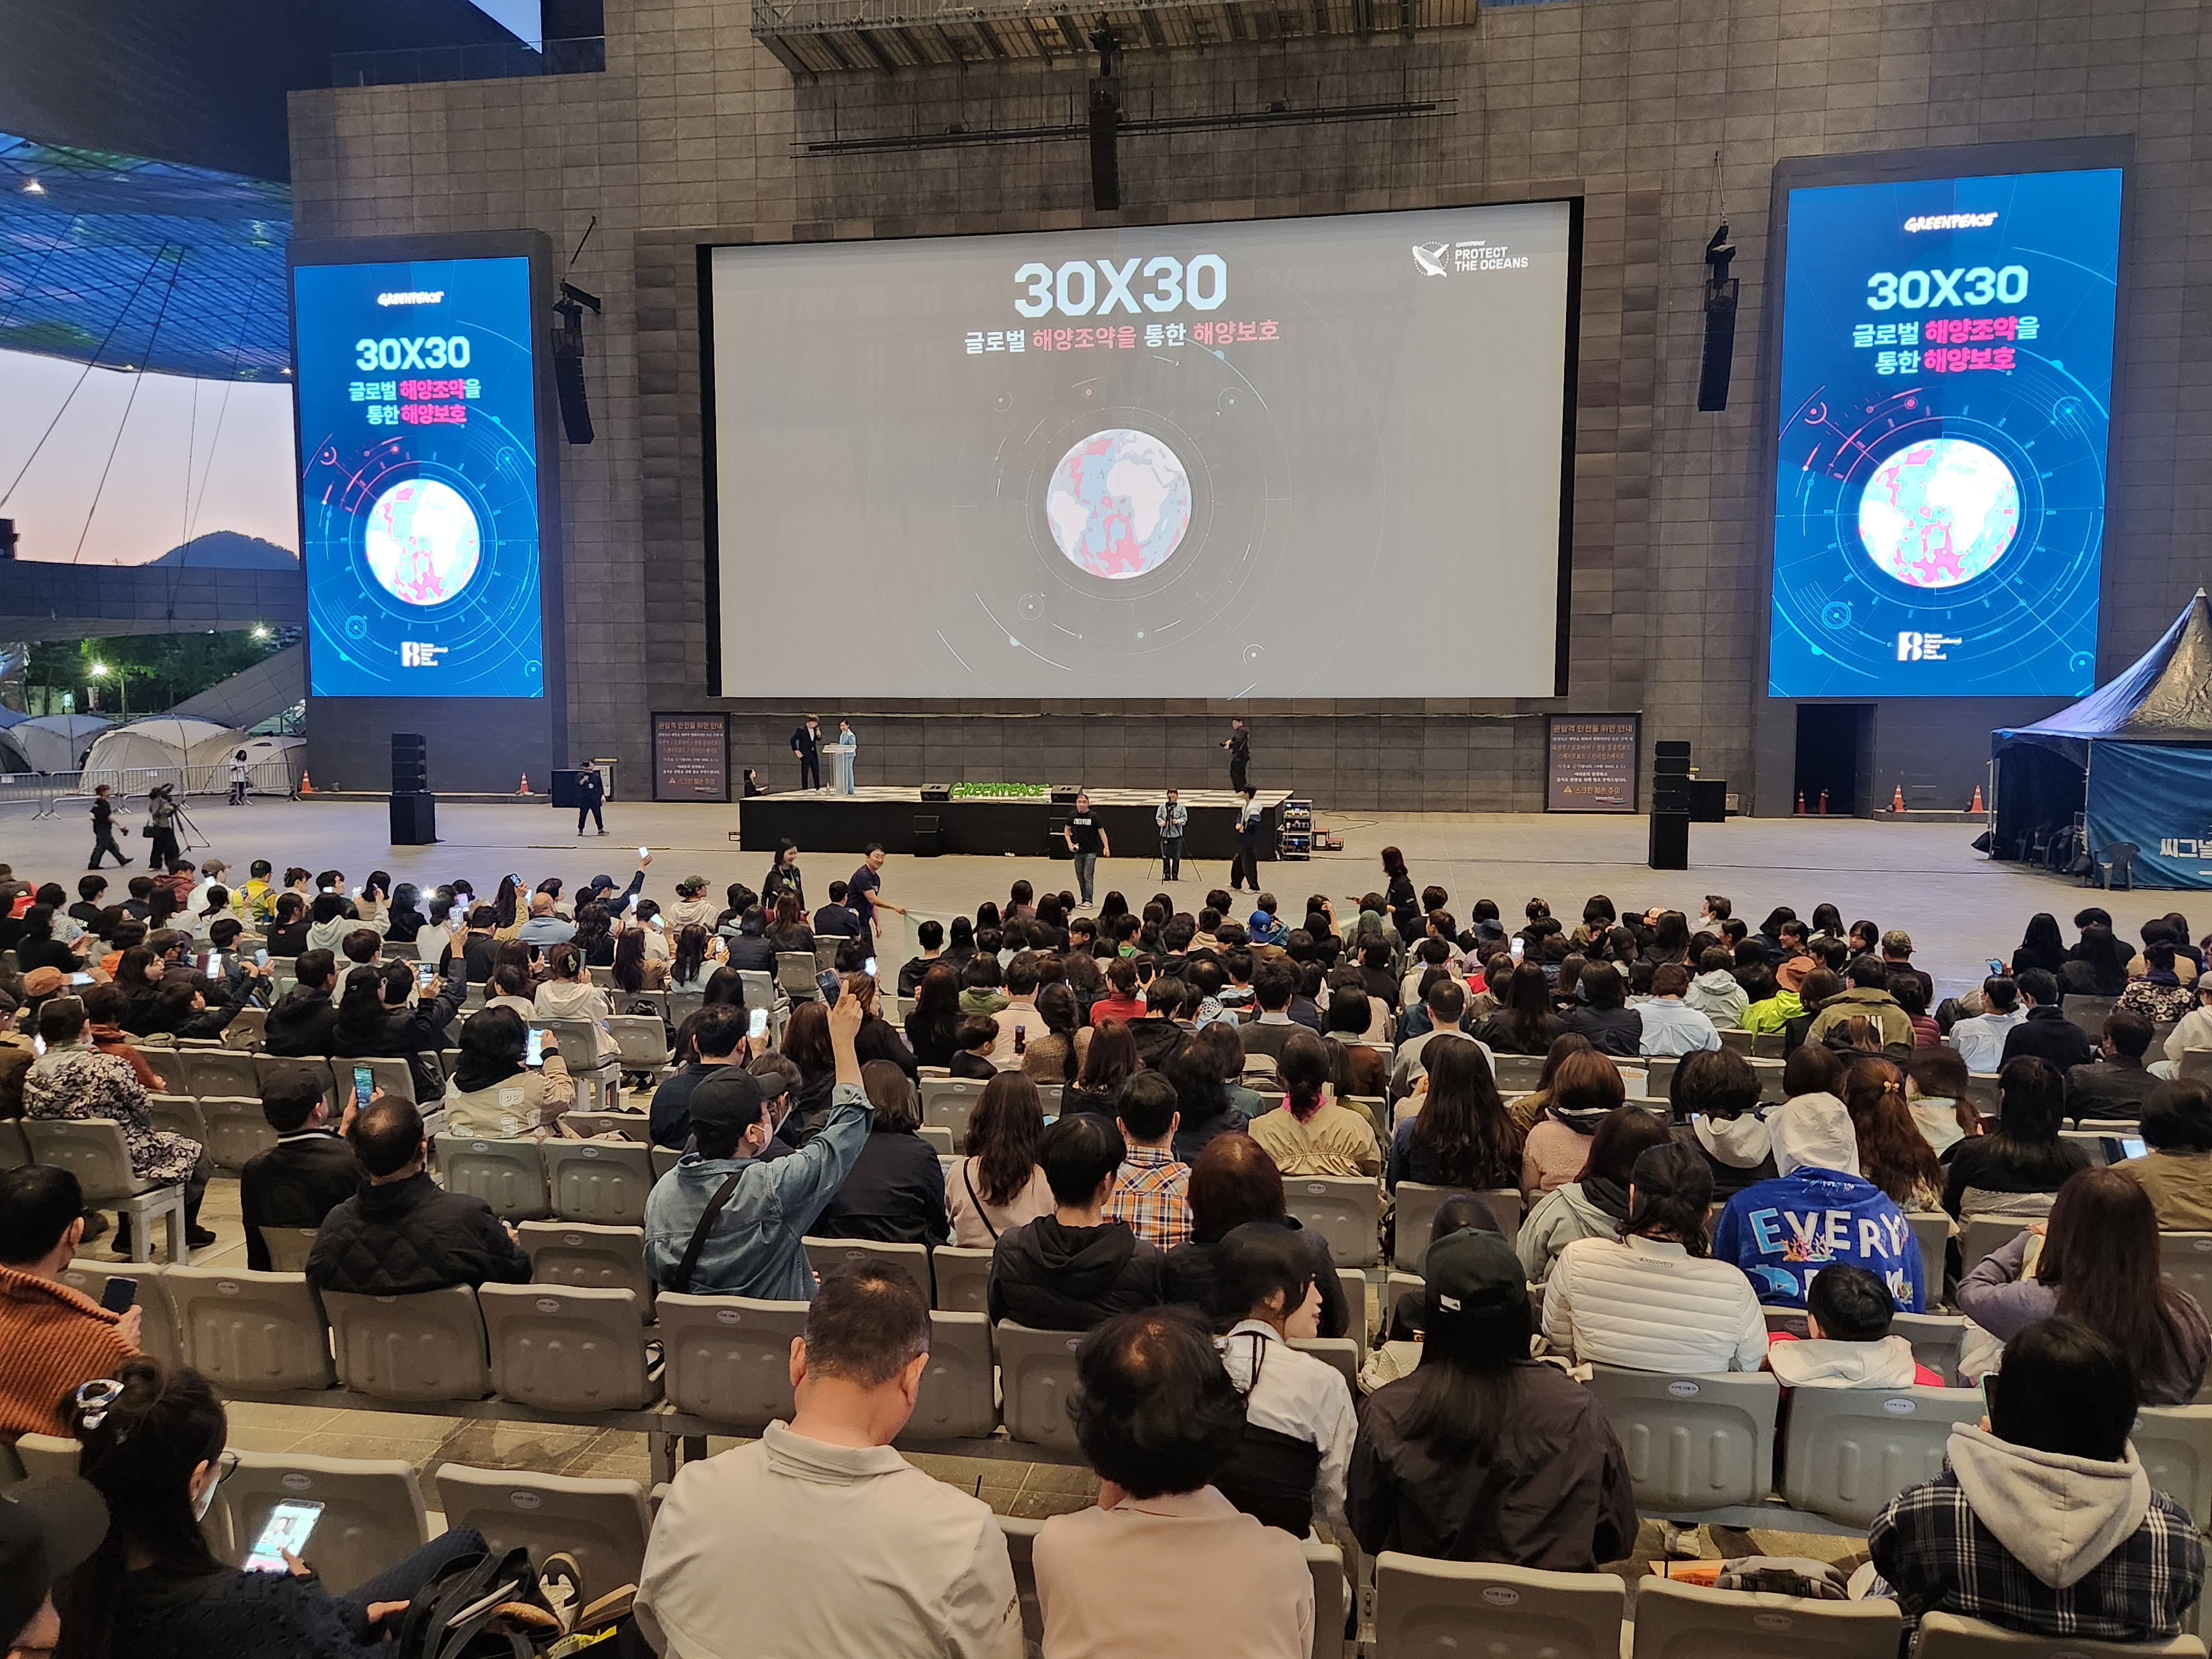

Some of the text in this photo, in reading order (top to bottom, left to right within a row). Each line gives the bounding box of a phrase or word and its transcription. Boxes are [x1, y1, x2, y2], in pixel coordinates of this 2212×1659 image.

[1904, 212, 1998, 233] GREENPEACE
[1454, 257, 1529, 272] THE OCEANS
[1455, 246, 1509, 260] PROTECT
[1014, 254, 1227, 318] 30X30
[1867, 265, 2029, 310] 30X30
[377, 291, 445, 307] GREENPEACE
[964, 319, 1280, 354] 글로벌 해양조약을 통한 해양보호
[1853, 315, 2040, 348] 글로벌 해양조약을
[356, 336, 470, 371] 30X30
[1875, 346, 2016, 375] 통한 해양보호
[348, 378, 481, 401] 글로벌 해양조약을
[366, 403, 467, 425] 통한 해양보호
[950, 782, 1050, 799] GREENPEACE
[1749, 1207, 1902, 1259] EVERY
[1642, 1257, 1674, 1267] Discovery
